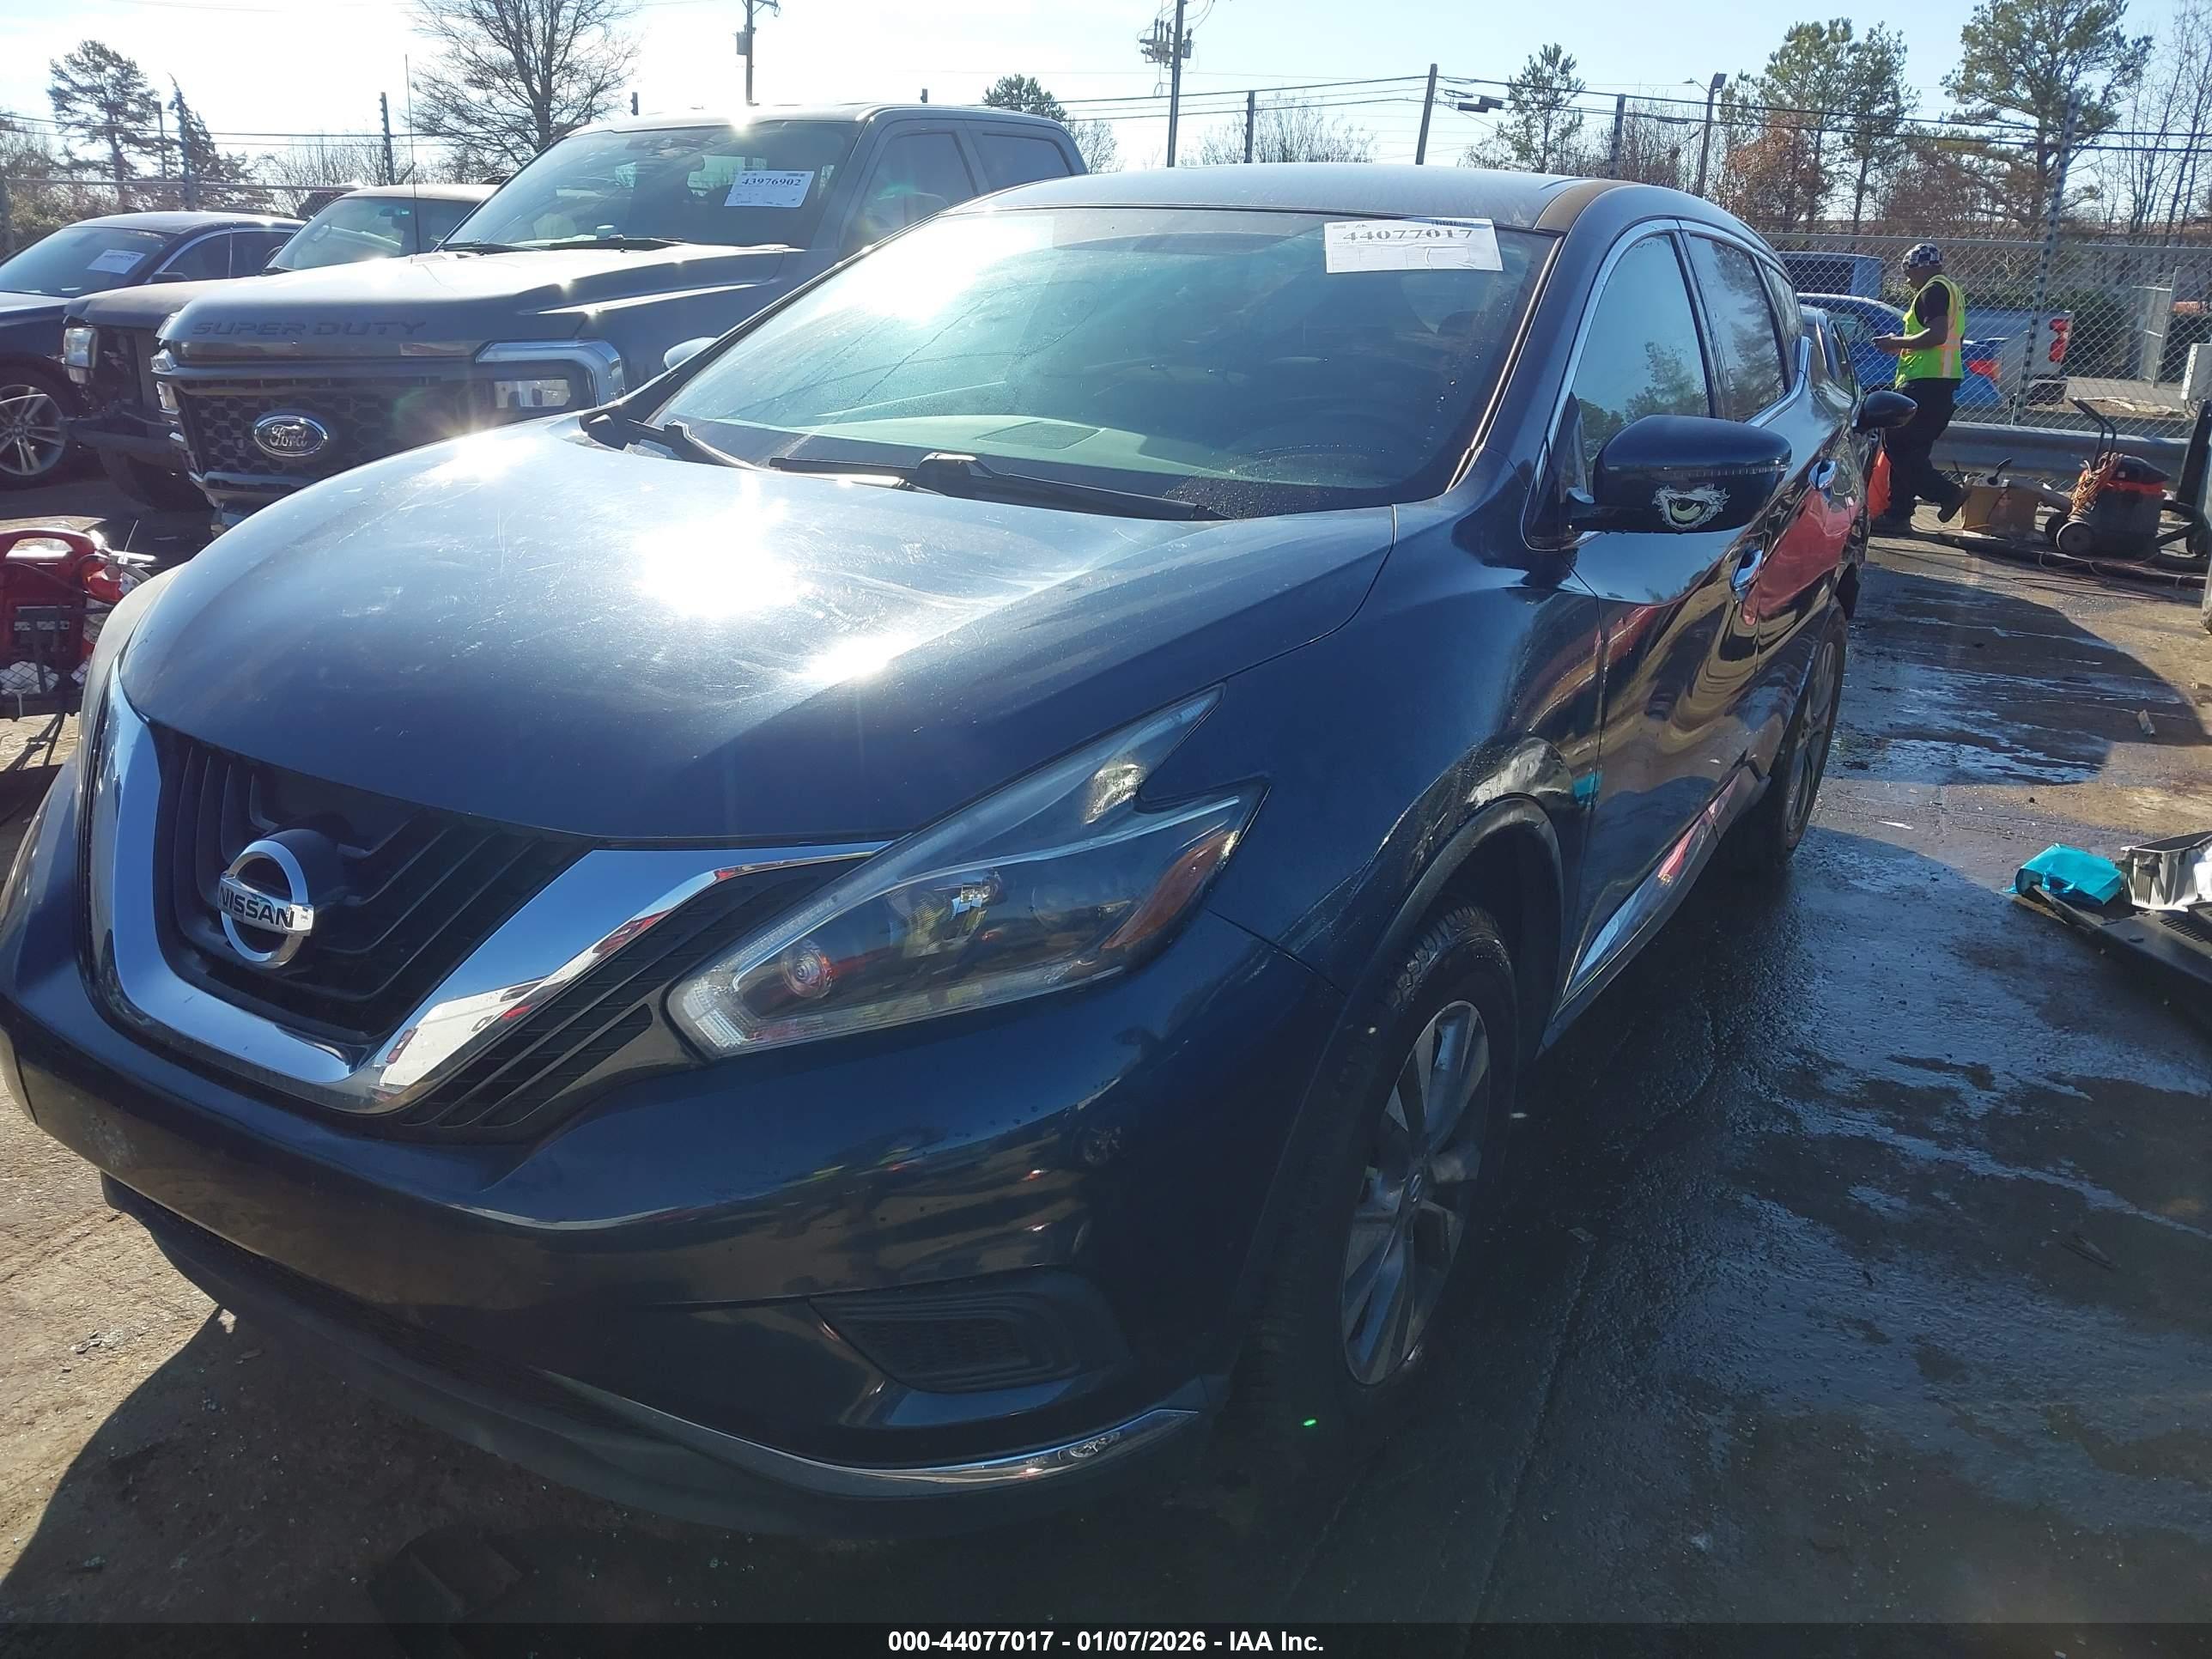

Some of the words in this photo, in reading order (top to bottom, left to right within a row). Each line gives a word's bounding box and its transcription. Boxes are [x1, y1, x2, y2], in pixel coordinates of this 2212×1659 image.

[1343, 229, 1473, 240] 44077017
[191, 321, 308, 336] SUPER
[313, 321, 427, 335] DUTY
[269, 424, 307, 447] Ford
[220, 887, 295, 928] NISSAN
